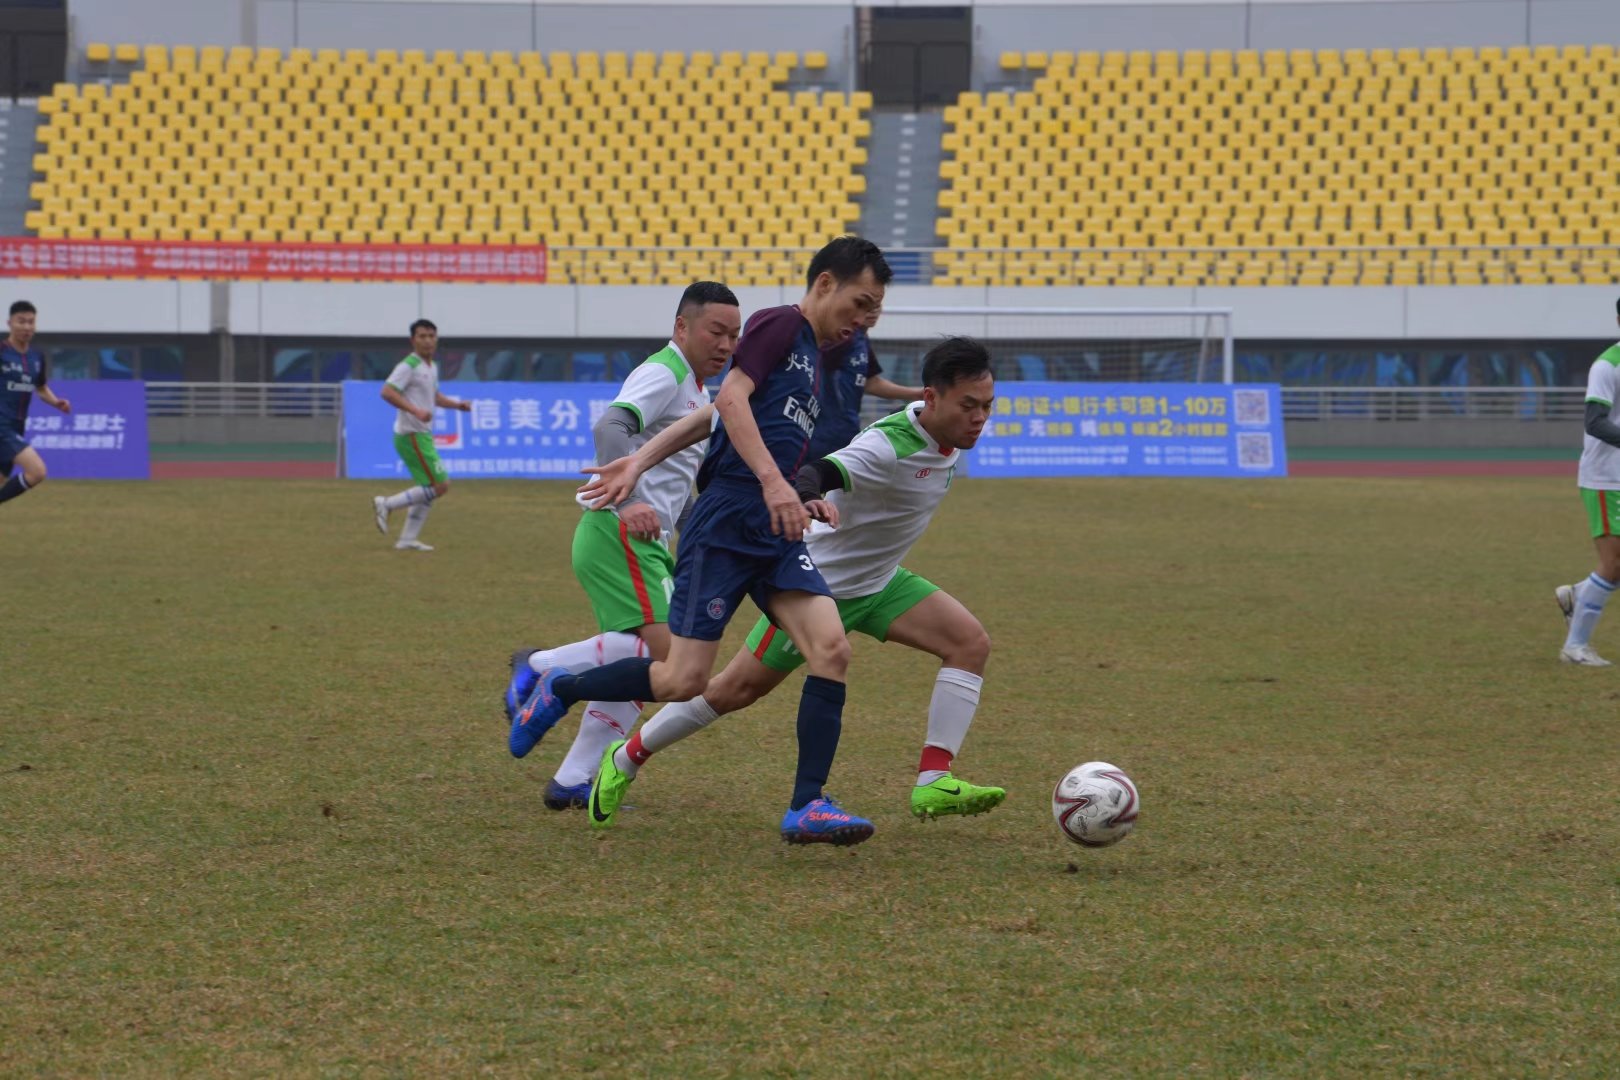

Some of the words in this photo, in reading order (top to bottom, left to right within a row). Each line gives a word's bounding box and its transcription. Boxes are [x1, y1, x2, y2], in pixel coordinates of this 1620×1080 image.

[990, 396, 1226, 416] 身份证+银行卡可贷1-10万
